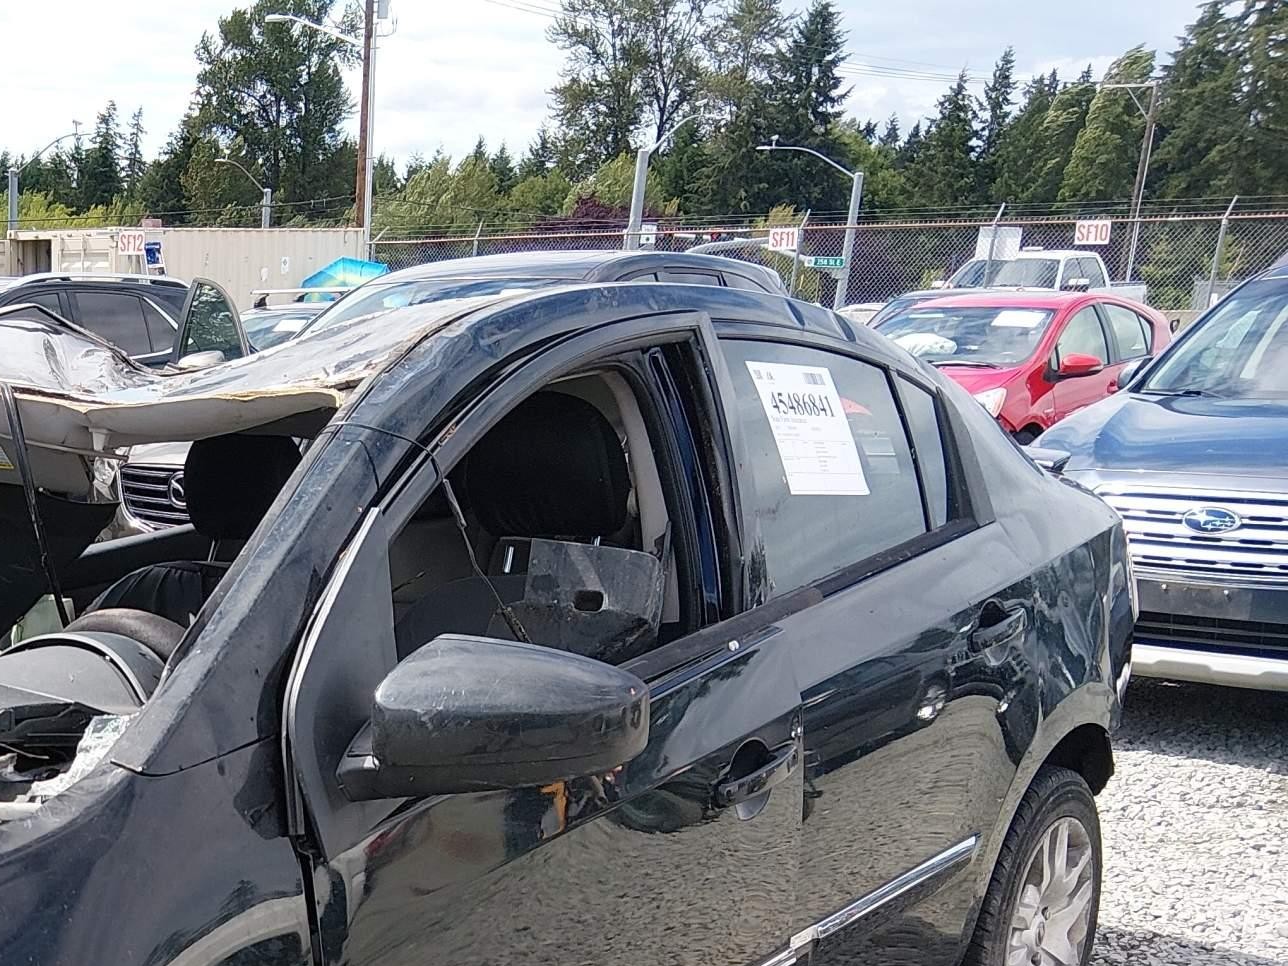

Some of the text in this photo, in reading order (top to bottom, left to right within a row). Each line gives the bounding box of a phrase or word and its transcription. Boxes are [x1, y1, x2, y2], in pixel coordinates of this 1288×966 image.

[772, 231, 795, 248] SF11
[1077, 223, 1109, 242] SF10
[120, 233, 144, 252] SF12
[771, 391, 835, 417] 45486841
